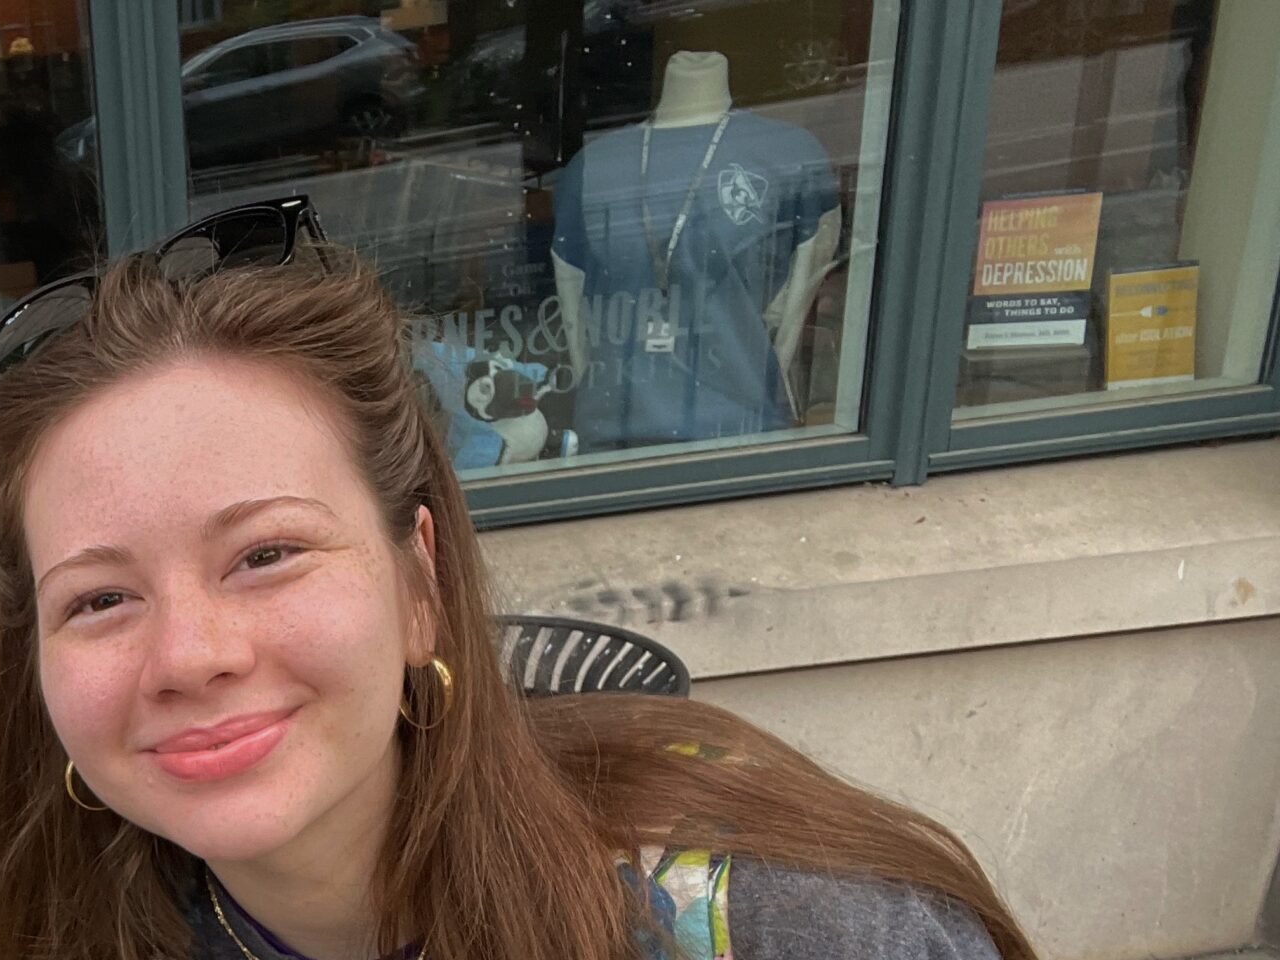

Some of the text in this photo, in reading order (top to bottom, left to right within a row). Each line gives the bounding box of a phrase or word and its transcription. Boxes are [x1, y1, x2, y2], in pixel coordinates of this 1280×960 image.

[987, 205, 1058, 232] HELPING
[984, 234, 1082, 259] OTHERS with
[981, 258, 1089, 286] DEPRESSION
[986, 297, 1061, 309] WORDS TO SAY,
[1004, 306, 1075, 317] THINGS TO DO
